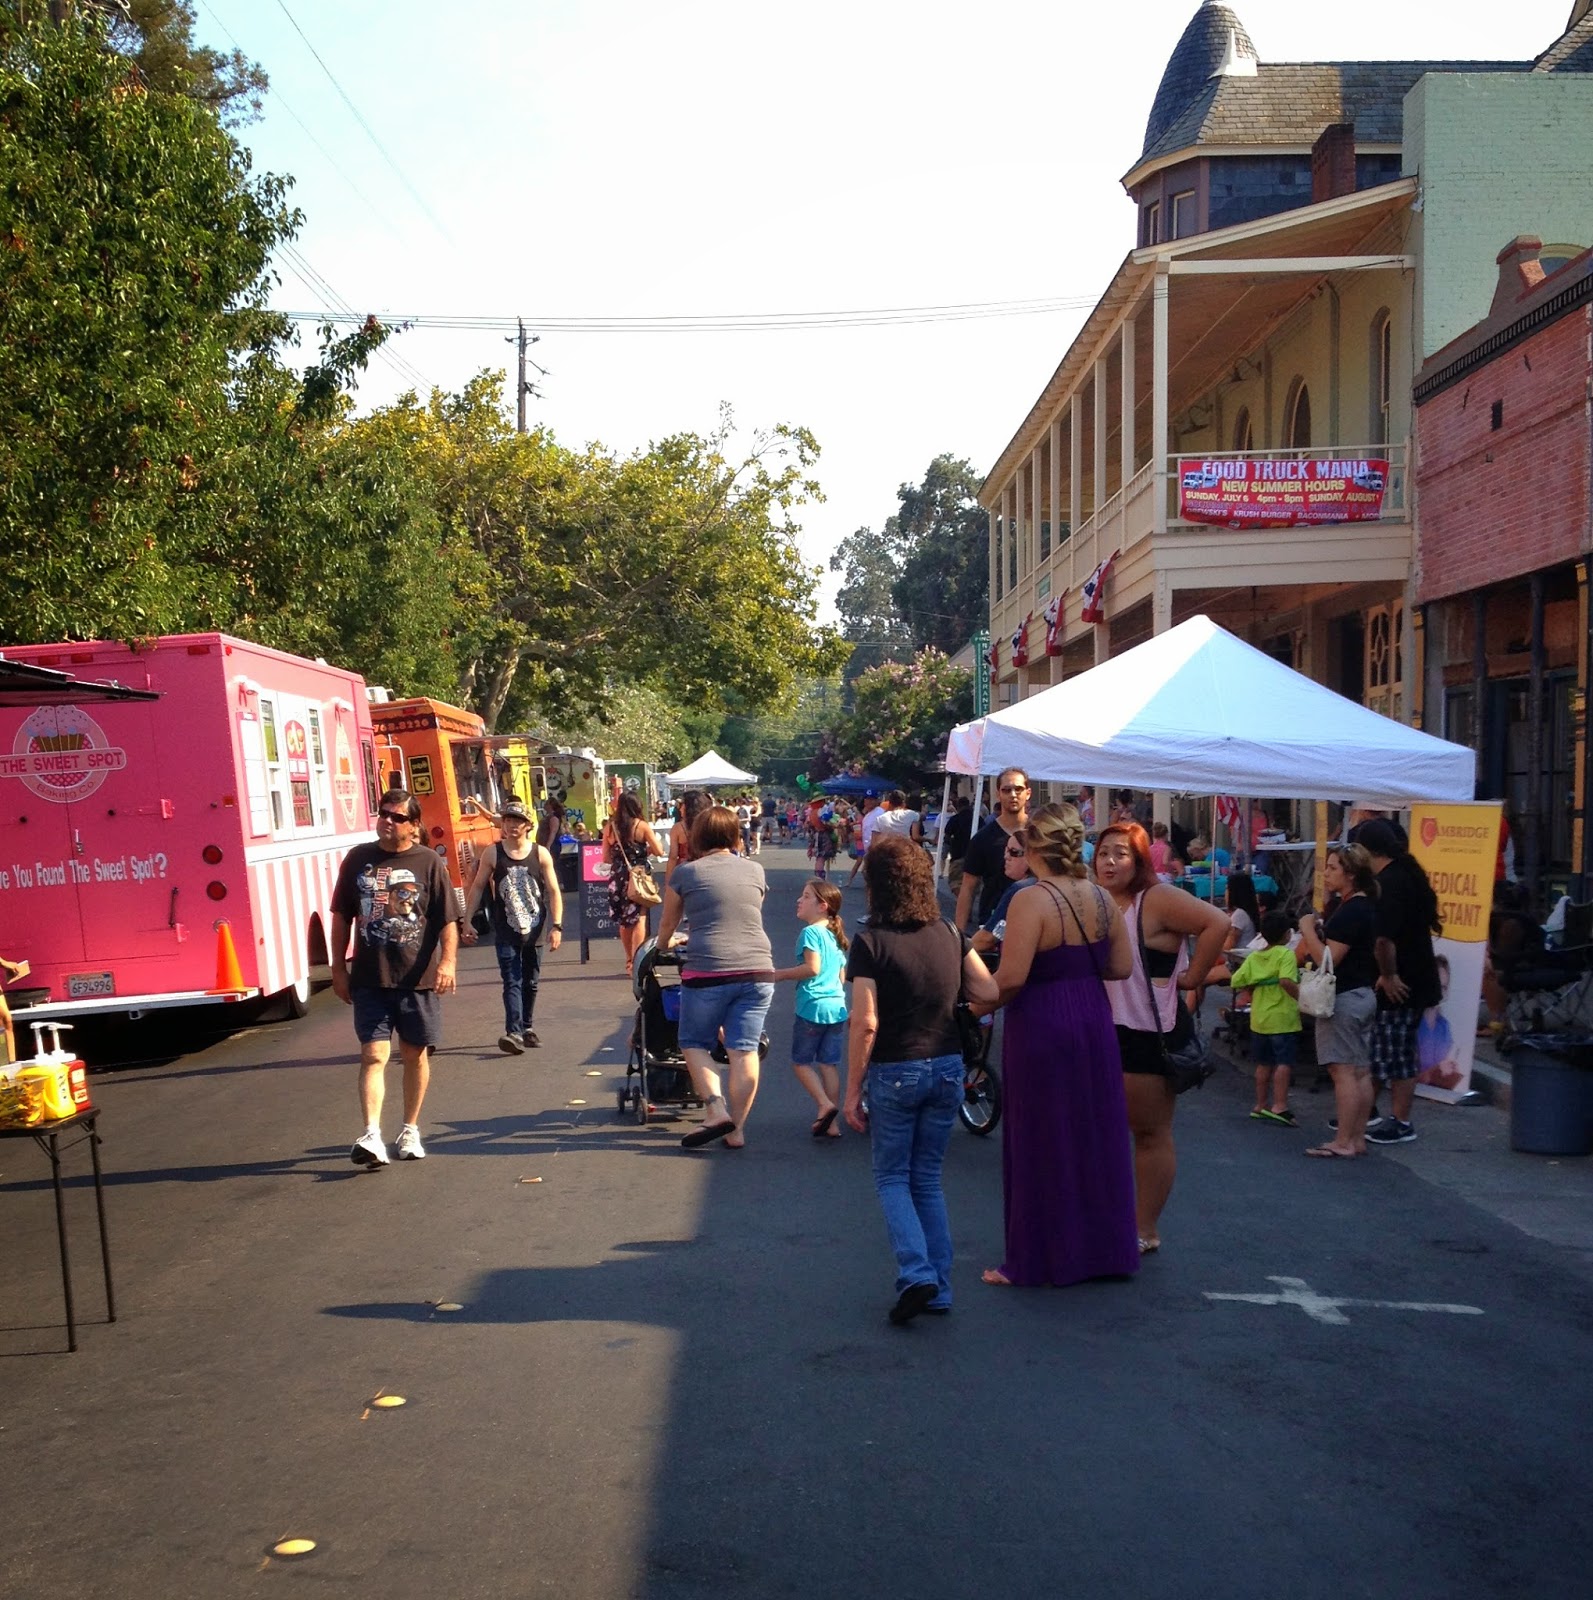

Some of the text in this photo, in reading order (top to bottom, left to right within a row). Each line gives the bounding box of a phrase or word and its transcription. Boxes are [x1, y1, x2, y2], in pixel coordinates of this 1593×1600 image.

[1202, 461, 1369, 480] FOOD TRUCK MANIA
[1222, 480, 1346, 493] NEW SUMMER HOURS
[1185, 491, 1220, 502] SUNDAY,
[1222, 494, 1242, 502] JULY
[1256, 494, 1277, 504] 4pm
[1284, 494, 1304, 504] 8pm
[1308, 493, 1344, 503] SUNDAY,
[1346, 492, 1376, 502] AUGUST
[1233, 510, 1259, 518] KRUSH
[2, 752, 122, 773] THE SWEET SPOT
[36, 782, 78, 799] Baking
[12, 864, 33, 888] You
[35, 861, 66, 886] Found
[68, 859, 90, 883] The
[94, 855, 127, 882] Sweet
[130, 852, 168, 884] Spot?
